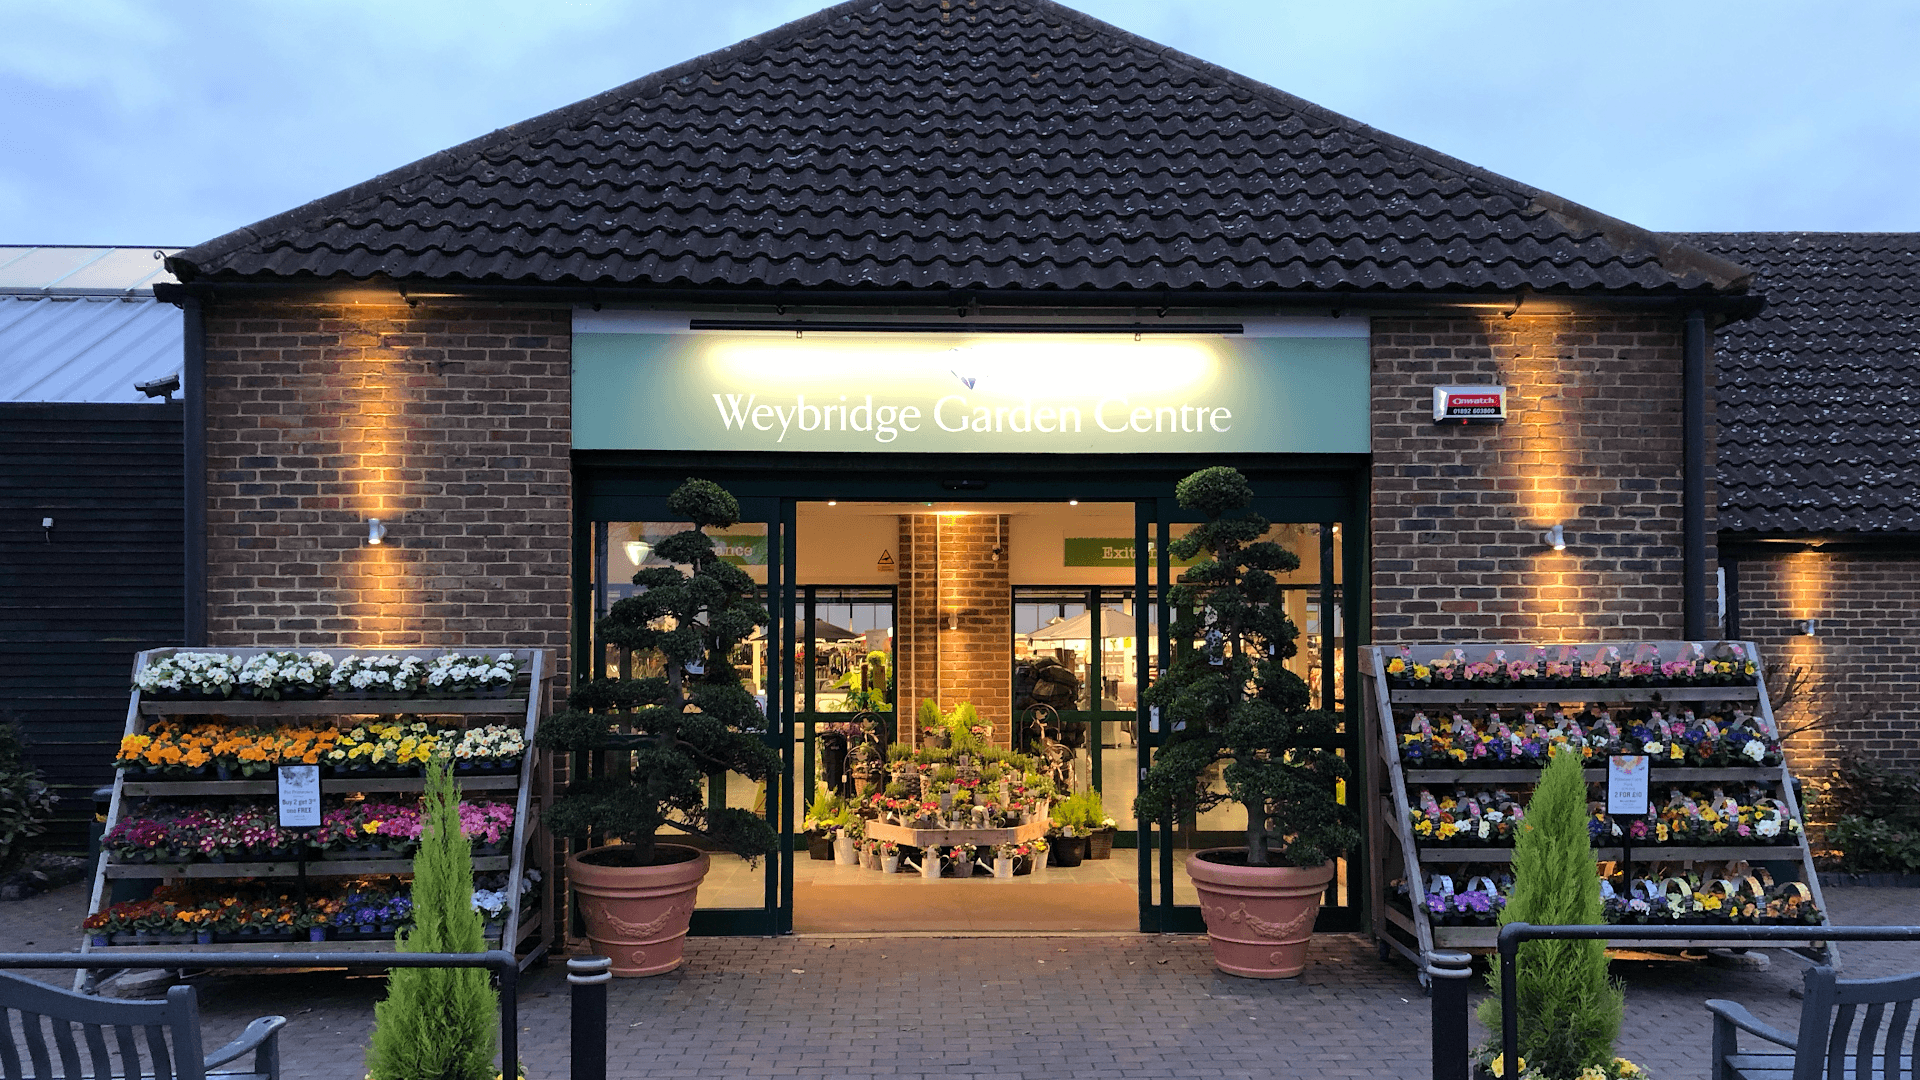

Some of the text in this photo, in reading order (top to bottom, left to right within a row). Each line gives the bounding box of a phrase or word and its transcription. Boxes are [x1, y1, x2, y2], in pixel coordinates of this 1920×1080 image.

[1452, 397, 1495, 405] Onwatch
[712, 394, 1232, 443] Weybridge Garden Centre
[1102, 546, 1136, 559] Exit
